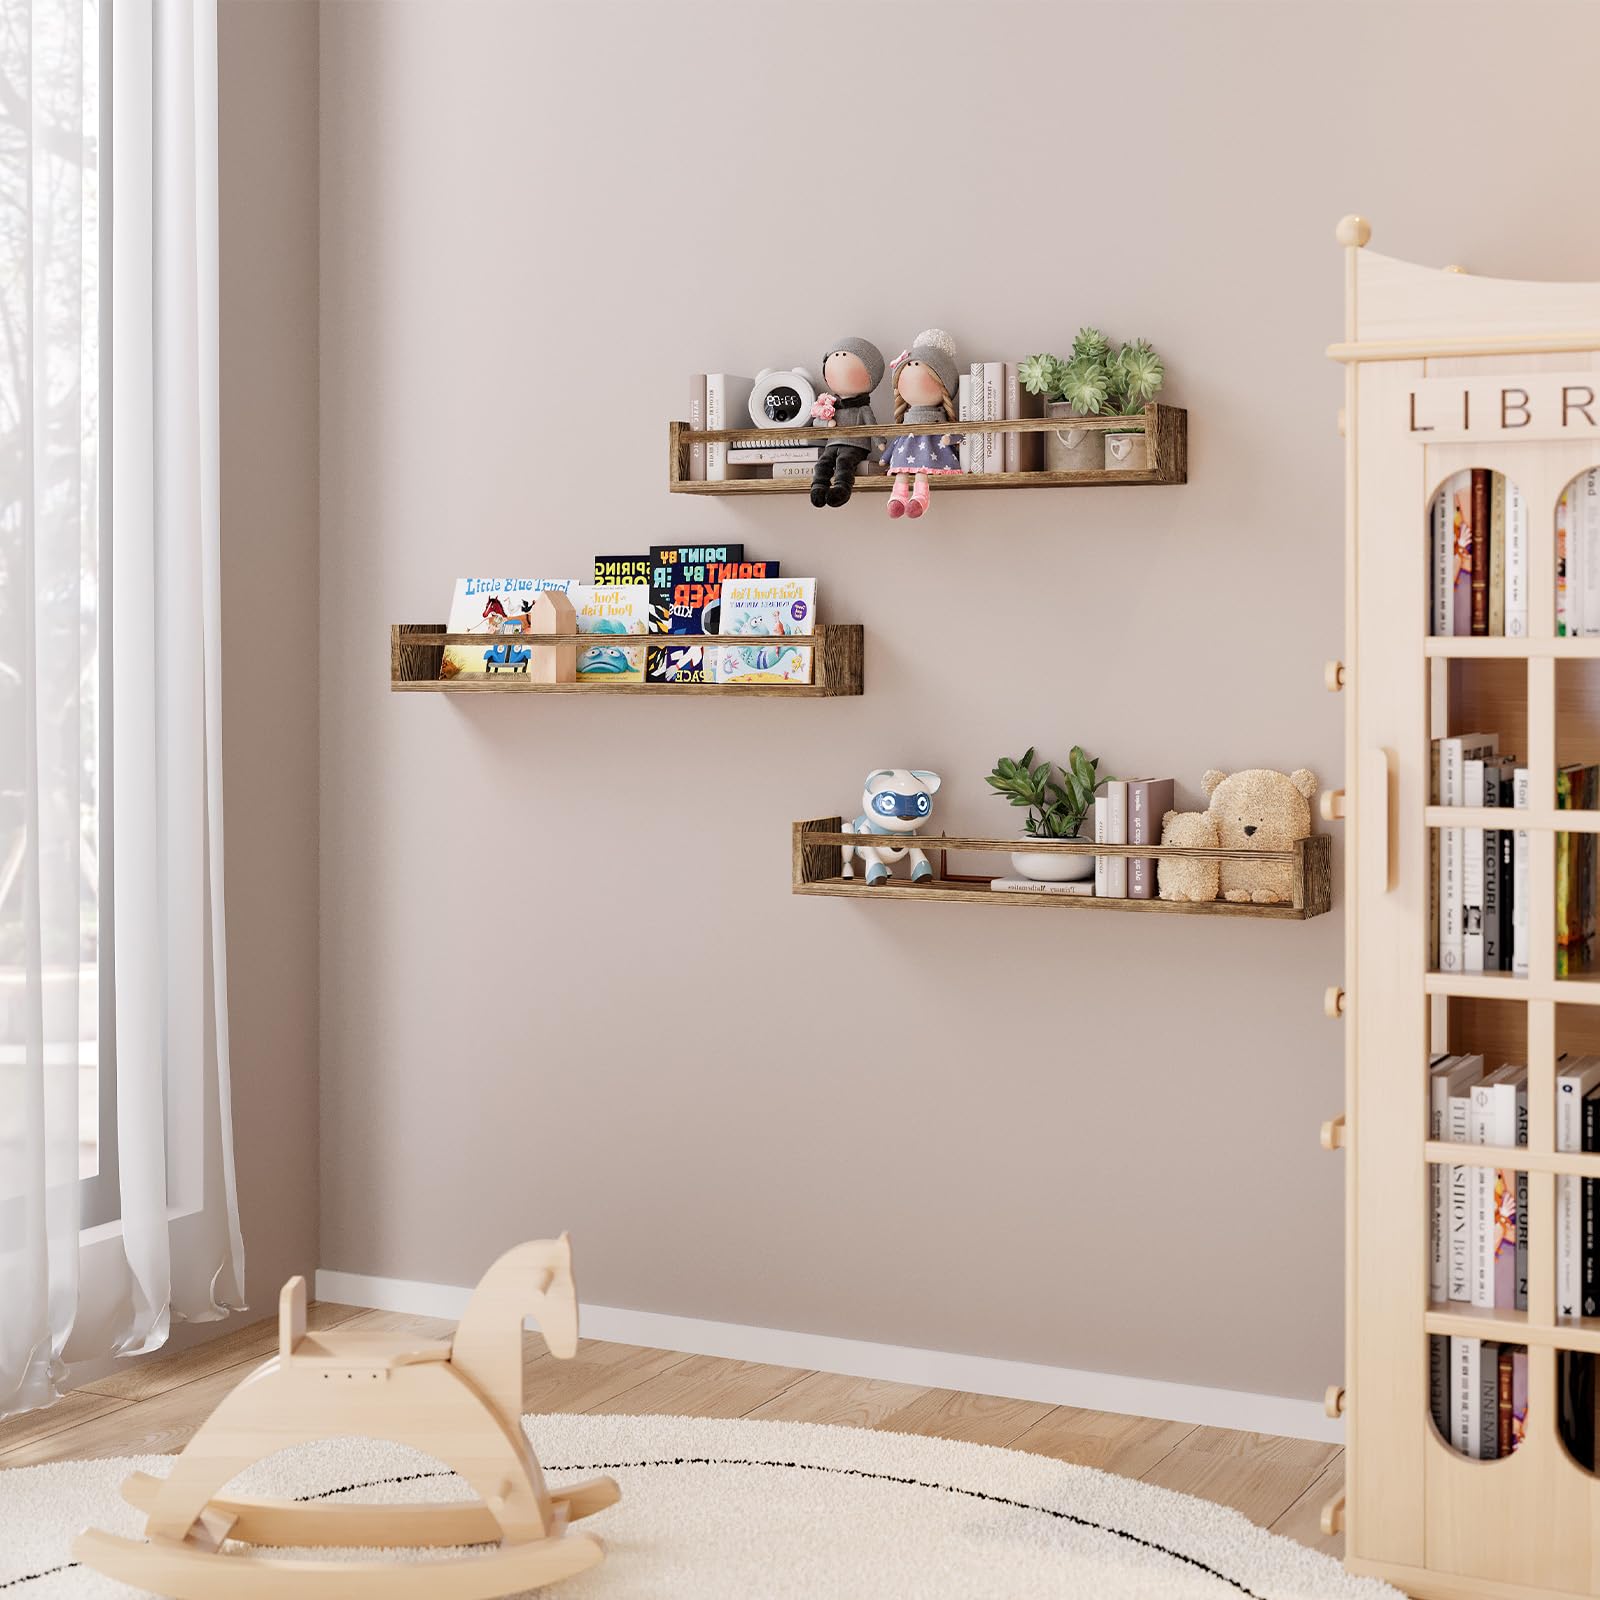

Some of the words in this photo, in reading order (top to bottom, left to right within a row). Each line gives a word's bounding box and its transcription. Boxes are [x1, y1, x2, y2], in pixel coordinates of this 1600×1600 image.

[1409, 386, 1597, 432] LIBR
[465, 578, 501, 596] Little
[504, 578, 533, 592] Blue
[1519, 779, 1528, 805] Ron
[1485, 780, 1496, 917] ARITECTURE
[1518, 1105, 1528, 1250] ARCECTURE
[1453, 1240, 1467, 1296] BOOK
[1483, 1380, 1495, 1459] INNENAR
